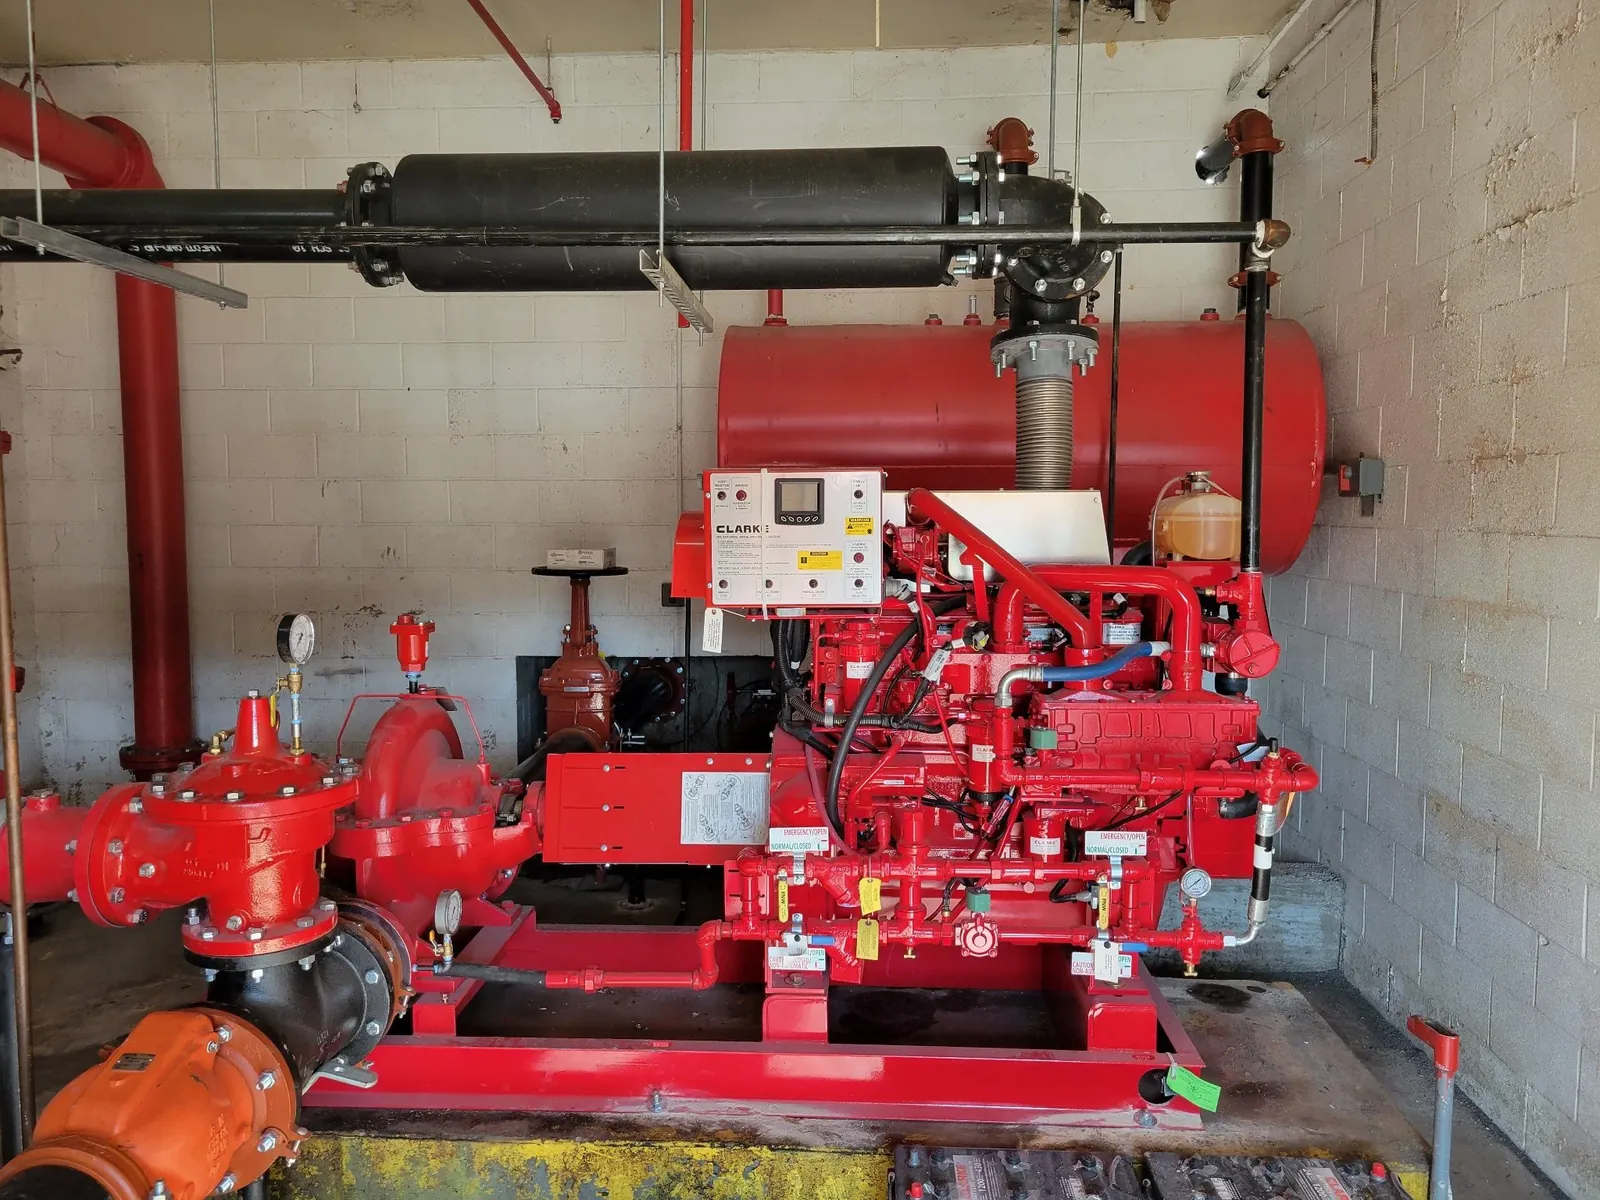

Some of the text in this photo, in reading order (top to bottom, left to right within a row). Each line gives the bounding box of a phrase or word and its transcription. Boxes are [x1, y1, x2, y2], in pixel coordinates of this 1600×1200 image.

[716, 525, 769, 533] CLARKE
[783, 828, 828, 836] EMERGENCY/OPEN
[1100, 832, 1146, 840] EMERGENCY/OPEN
[771, 842, 812, 850] NORMAL/CLOSED
[1086, 846, 1129, 854] NORMAL/CLOSED
